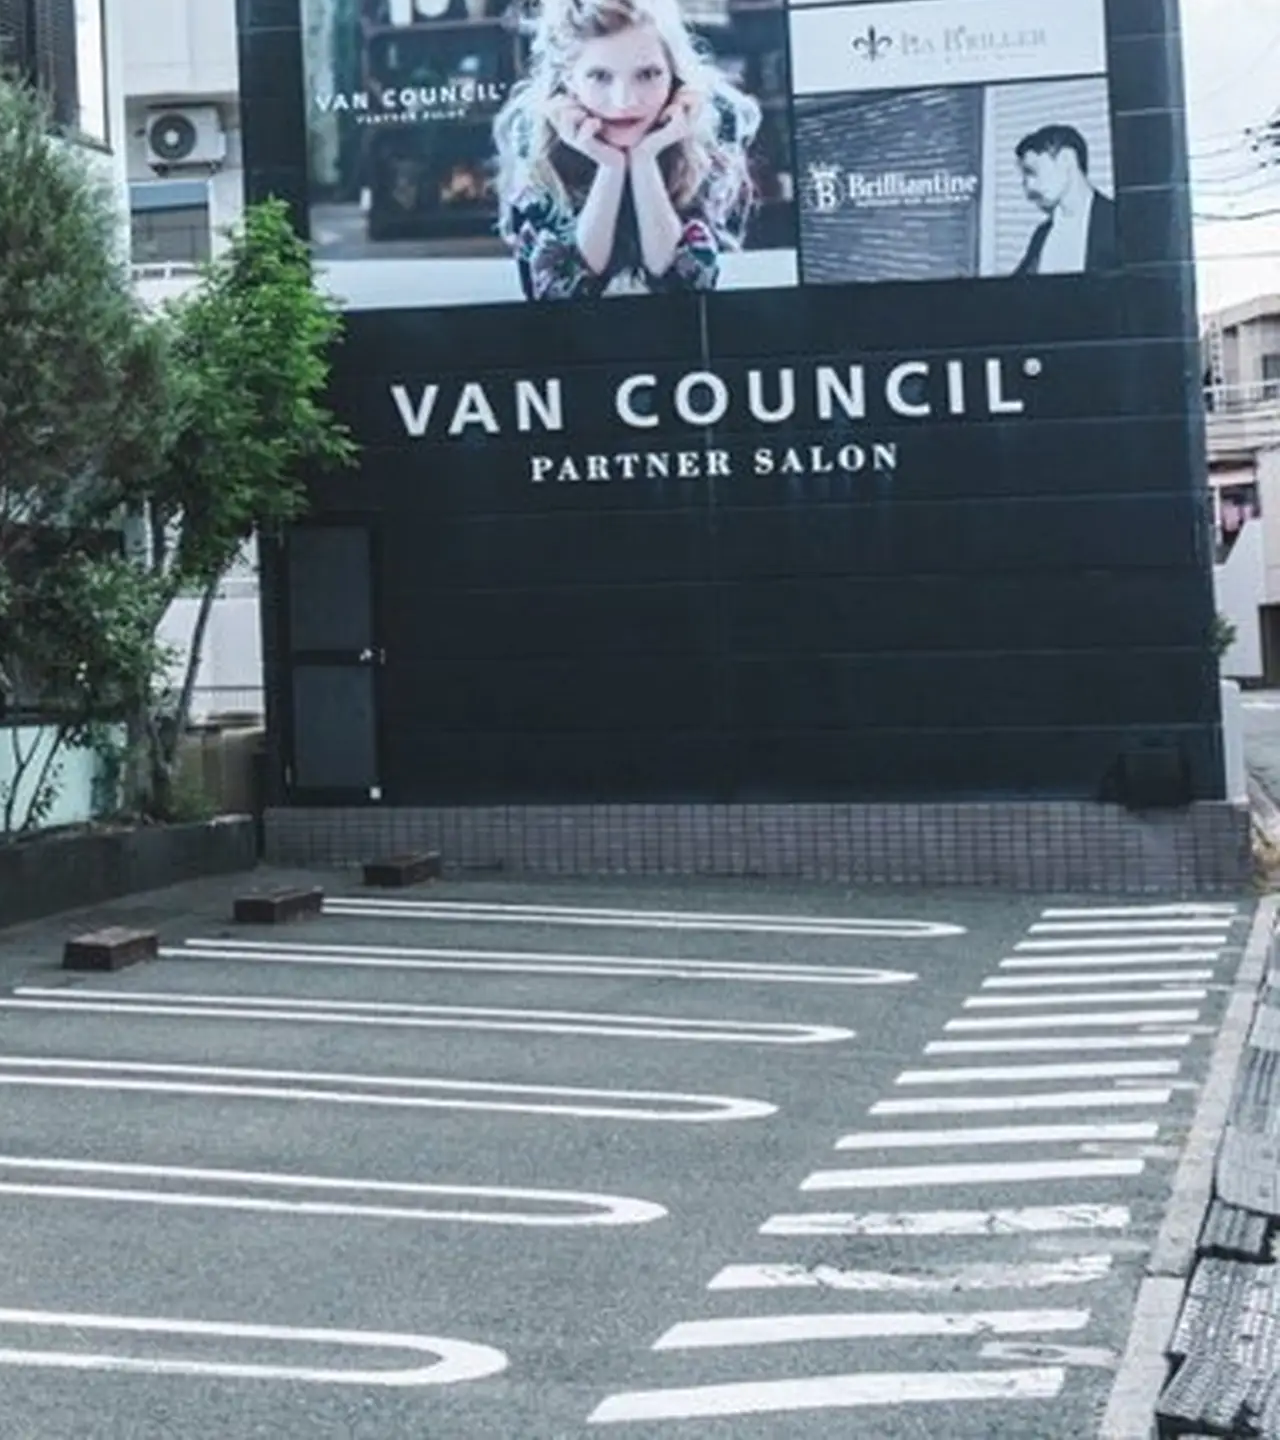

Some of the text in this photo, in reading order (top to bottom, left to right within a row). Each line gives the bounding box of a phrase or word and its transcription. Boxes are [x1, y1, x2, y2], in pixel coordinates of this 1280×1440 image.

[314, 82, 502, 111] VAN COUNCIL
[848, 169, 978, 198] Brilliantine
[390, 357, 1025, 437] VAN COUNCIL
[530, 442, 899, 483] PARTNER SALON
